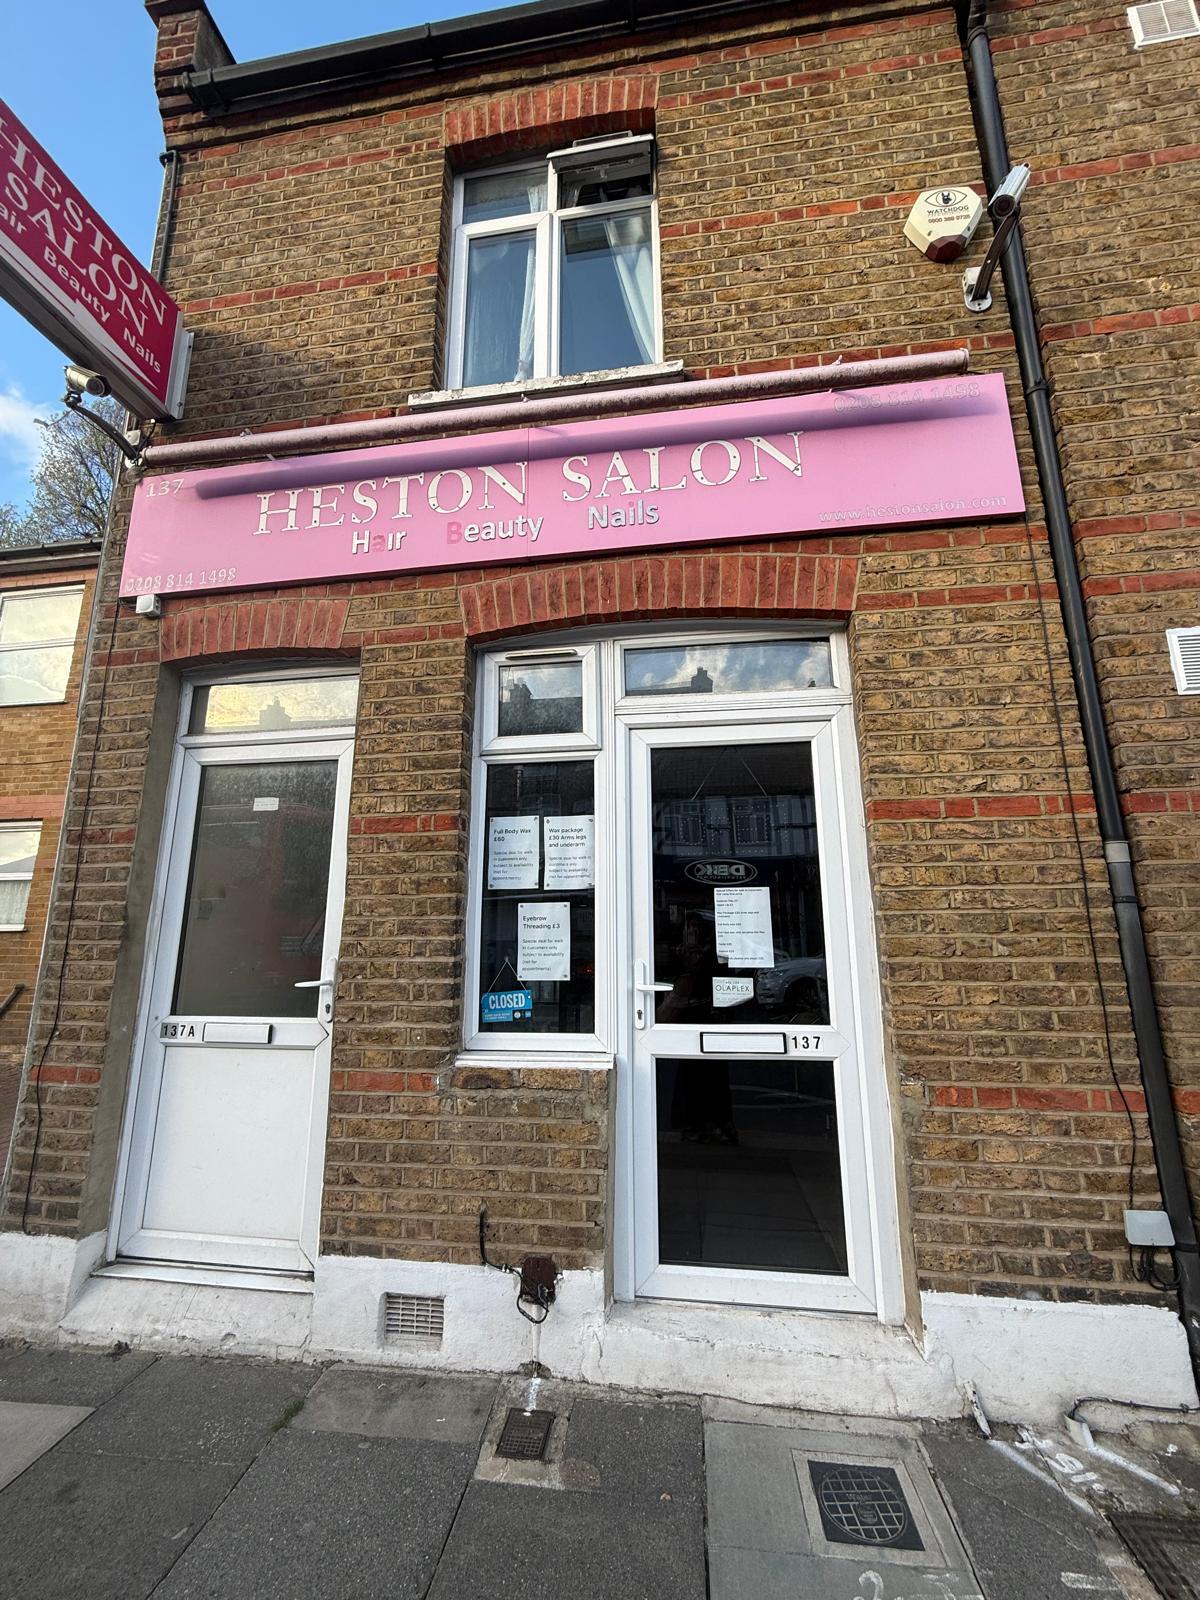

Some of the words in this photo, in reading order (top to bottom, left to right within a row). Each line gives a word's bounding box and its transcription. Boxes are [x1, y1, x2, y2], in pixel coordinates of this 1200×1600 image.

[927, 205, 969, 214] WATCHDOG
[5, 172, 148, 337] SALON
[44, 246, 110, 322] Beauty
[123, 327, 161, 373] Nails
[931, 382, 981, 401] 1498
[146, 478, 184, 497] 137
[253, 461, 527, 535] HESTON
[562, 431, 803, 502] SALON
[818, 495, 1007, 523] www.hestonsalon.com
[352, 530, 407, 554] Hair
[447, 514, 543, 545] Beauty
[588, 500, 660, 529] Nails
[166, 572, 193, 588] 814
[200, 567, 236, 584] 1498
[715, 984, 750, 992] OLAPLEX
[489, 993, 526, 1009] CLOSED
[163, 1024, 195, 1037] 137A
[791, 1036, 821, 1049] 137
